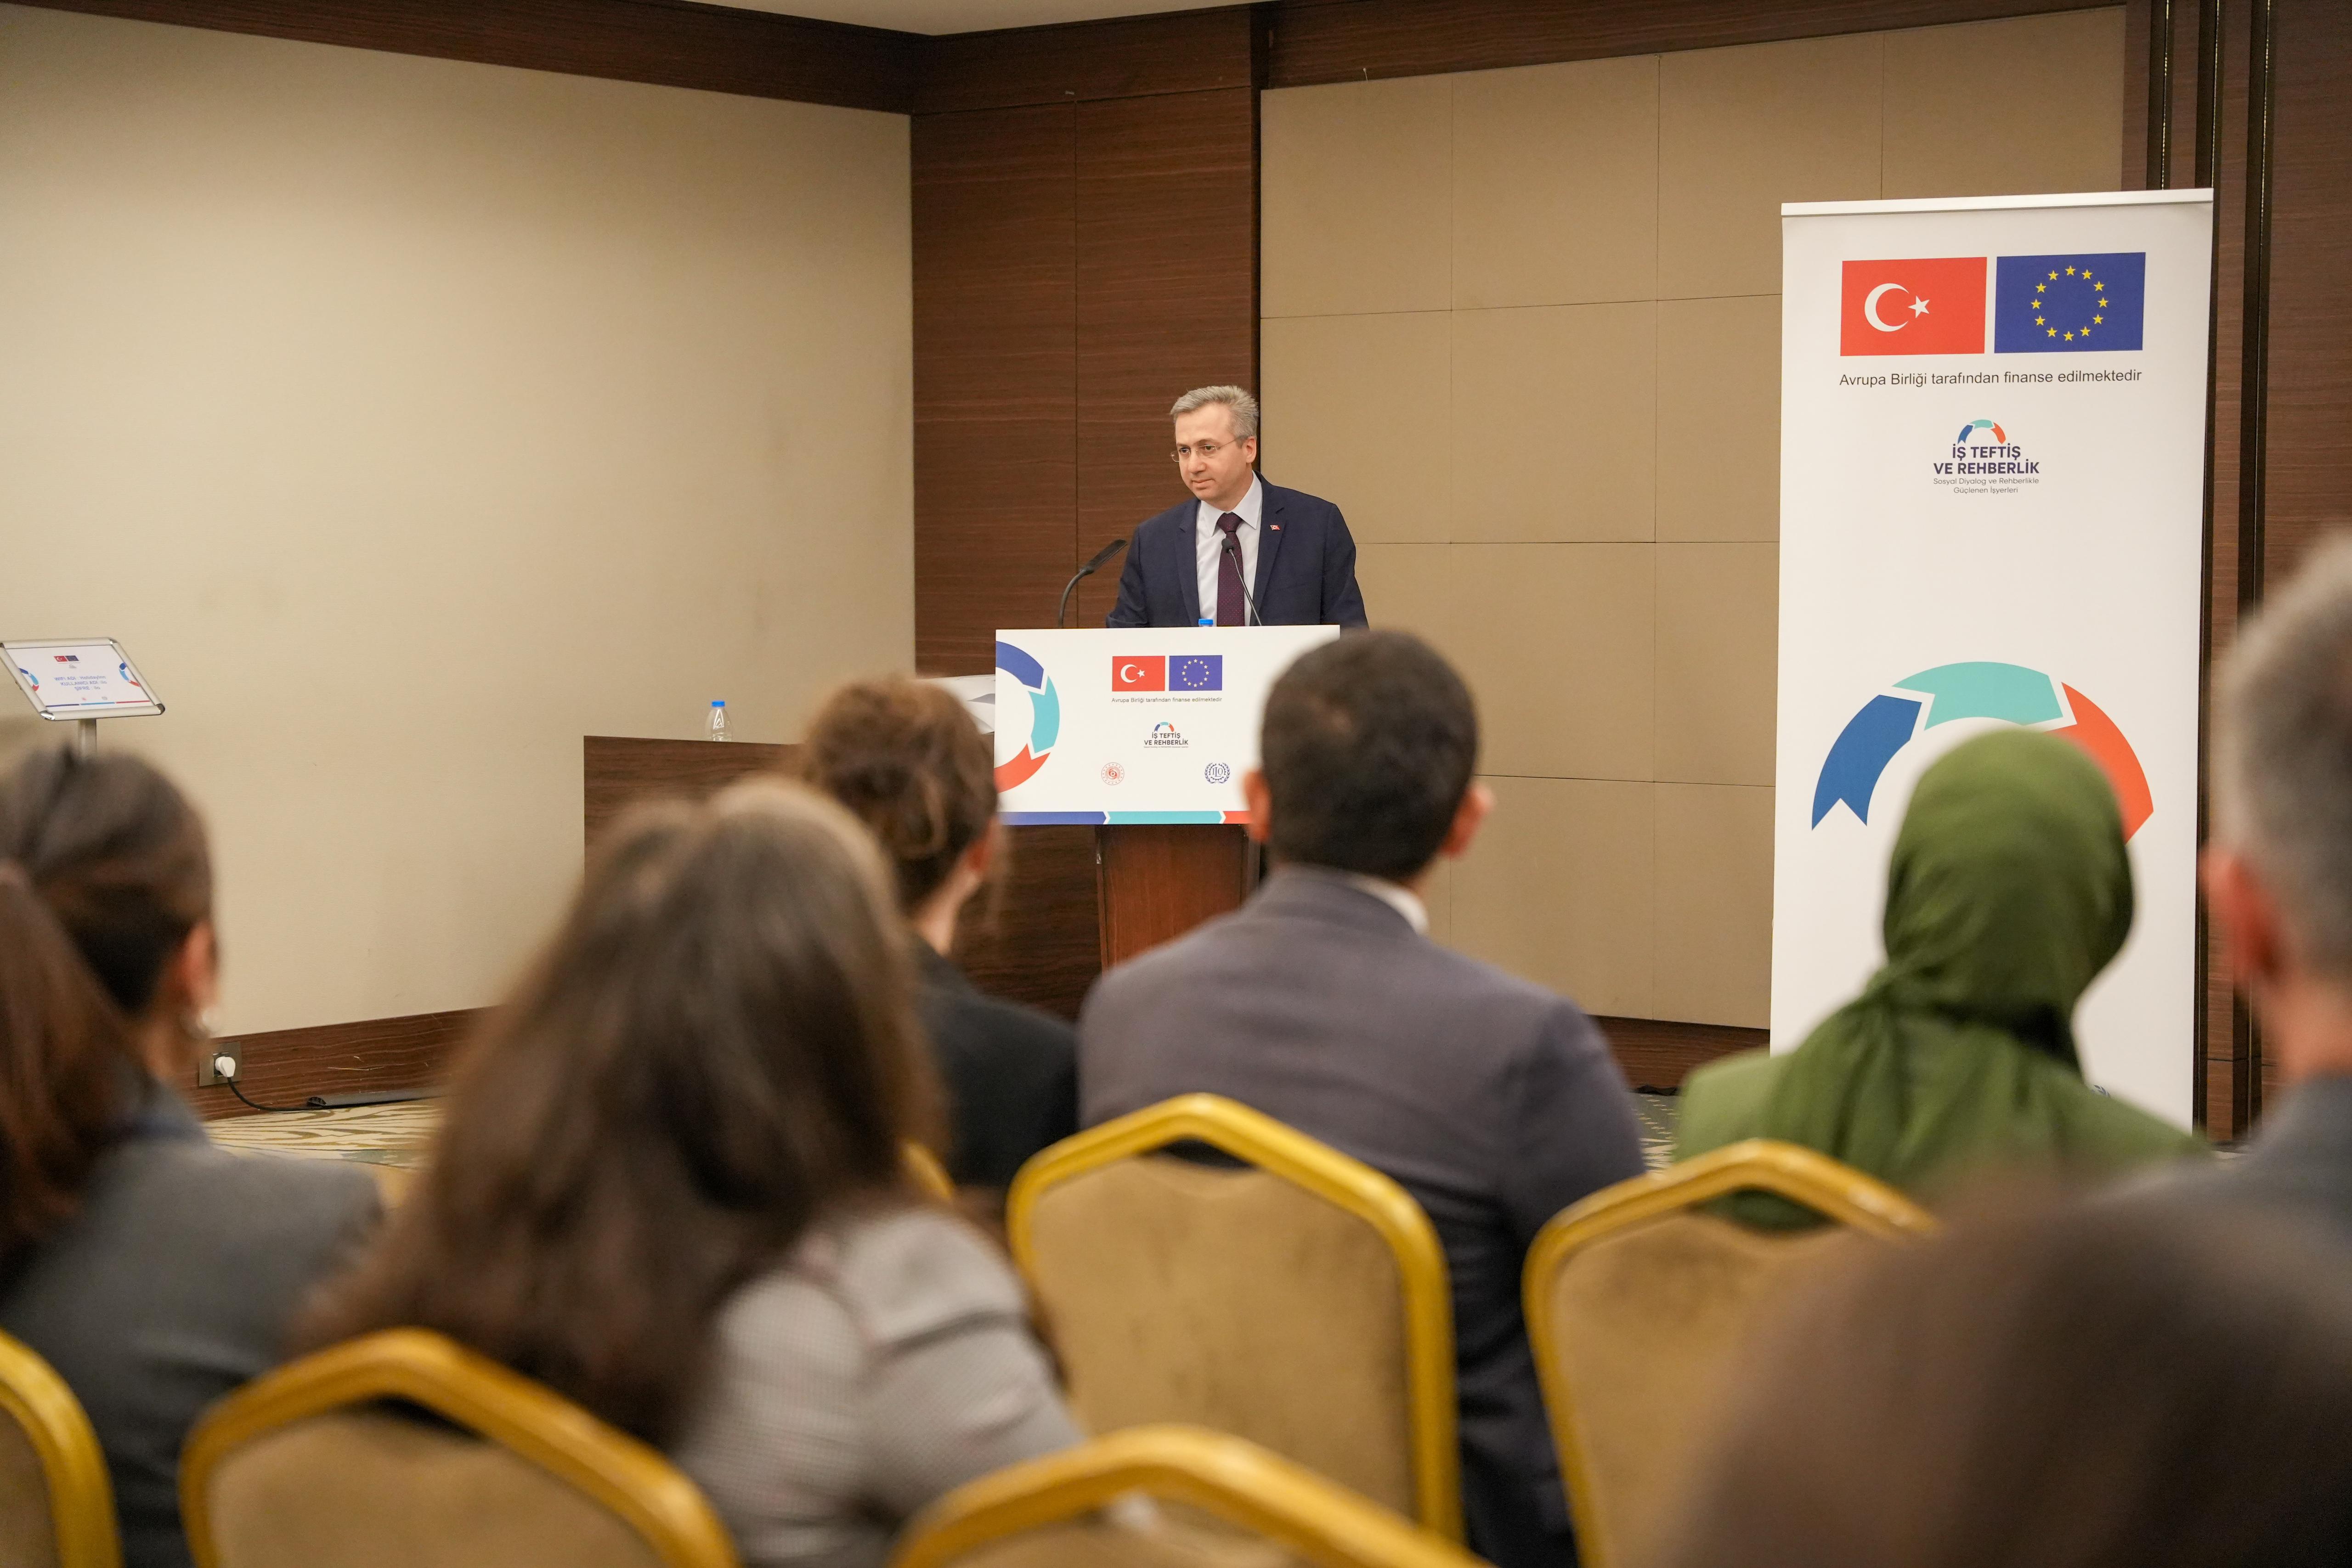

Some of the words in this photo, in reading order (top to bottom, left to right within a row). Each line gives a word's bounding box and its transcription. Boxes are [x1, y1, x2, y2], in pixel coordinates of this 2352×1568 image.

[1839, 374, 1886, 388] Avrupa
[1891, 373, 1927, 387] Birliği
[1931, 372, 1999, 384] tarafından
[2003, 371, 2053, 383] finanse
[2058, 369, 2143, 382] edilmektedir
[1952, 443, 1966, 461] İŞ
[1970, 443, 2021, 460] TEFTİŞ
[1933, 463, 1953, 474] VE
[1957, 459, 2040, 474] REHBERLİK
[1212, 767, 1223, 777] ILO
